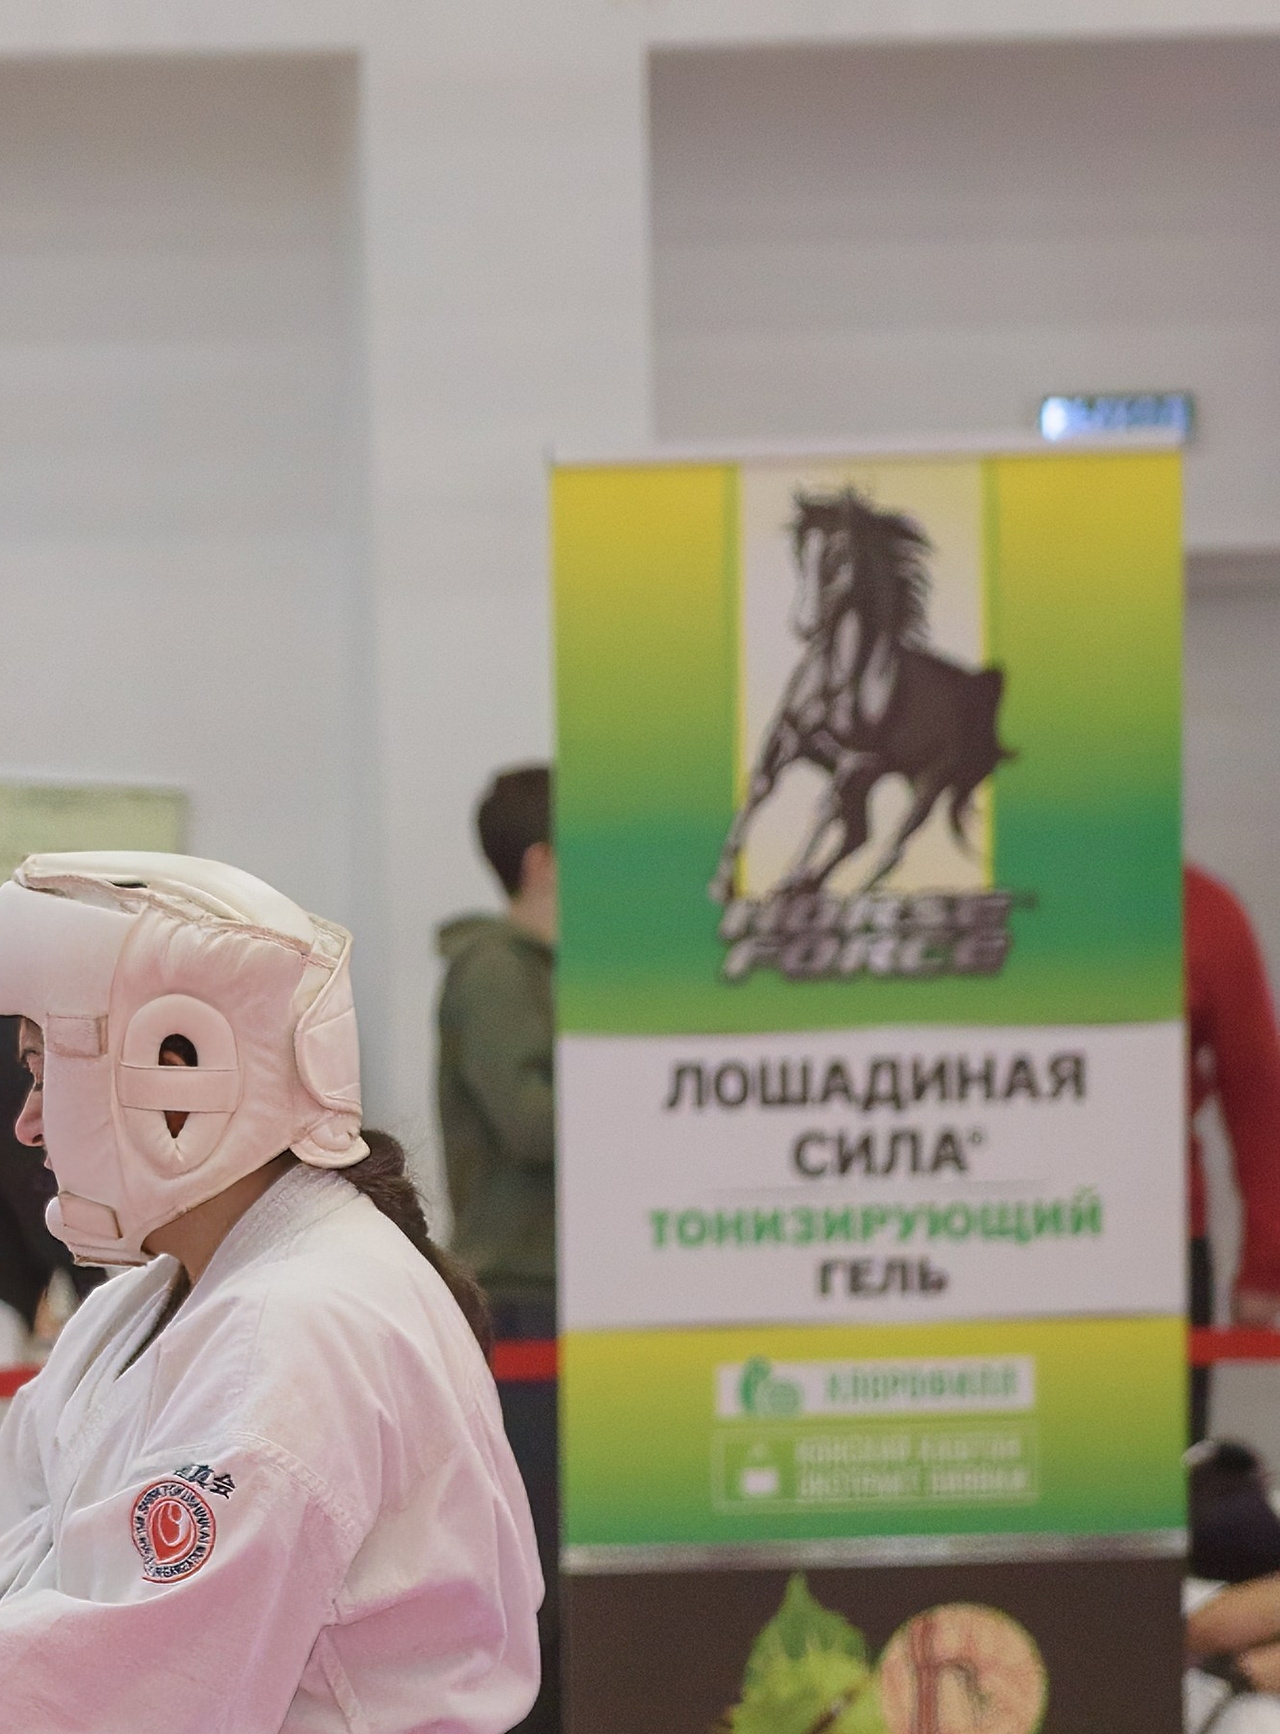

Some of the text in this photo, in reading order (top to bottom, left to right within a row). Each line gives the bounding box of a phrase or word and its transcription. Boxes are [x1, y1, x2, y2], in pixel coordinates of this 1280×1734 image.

[720, 931, 1012, 978] FORCE
[663, 1052, 1087, 1112] ЛОШАДИНАЯ
[649, 1184, 1103, 1248] ТОНИЗИРУЮЩИЙ
[816, 1254, 949, 1299] ГЕЛЬ
